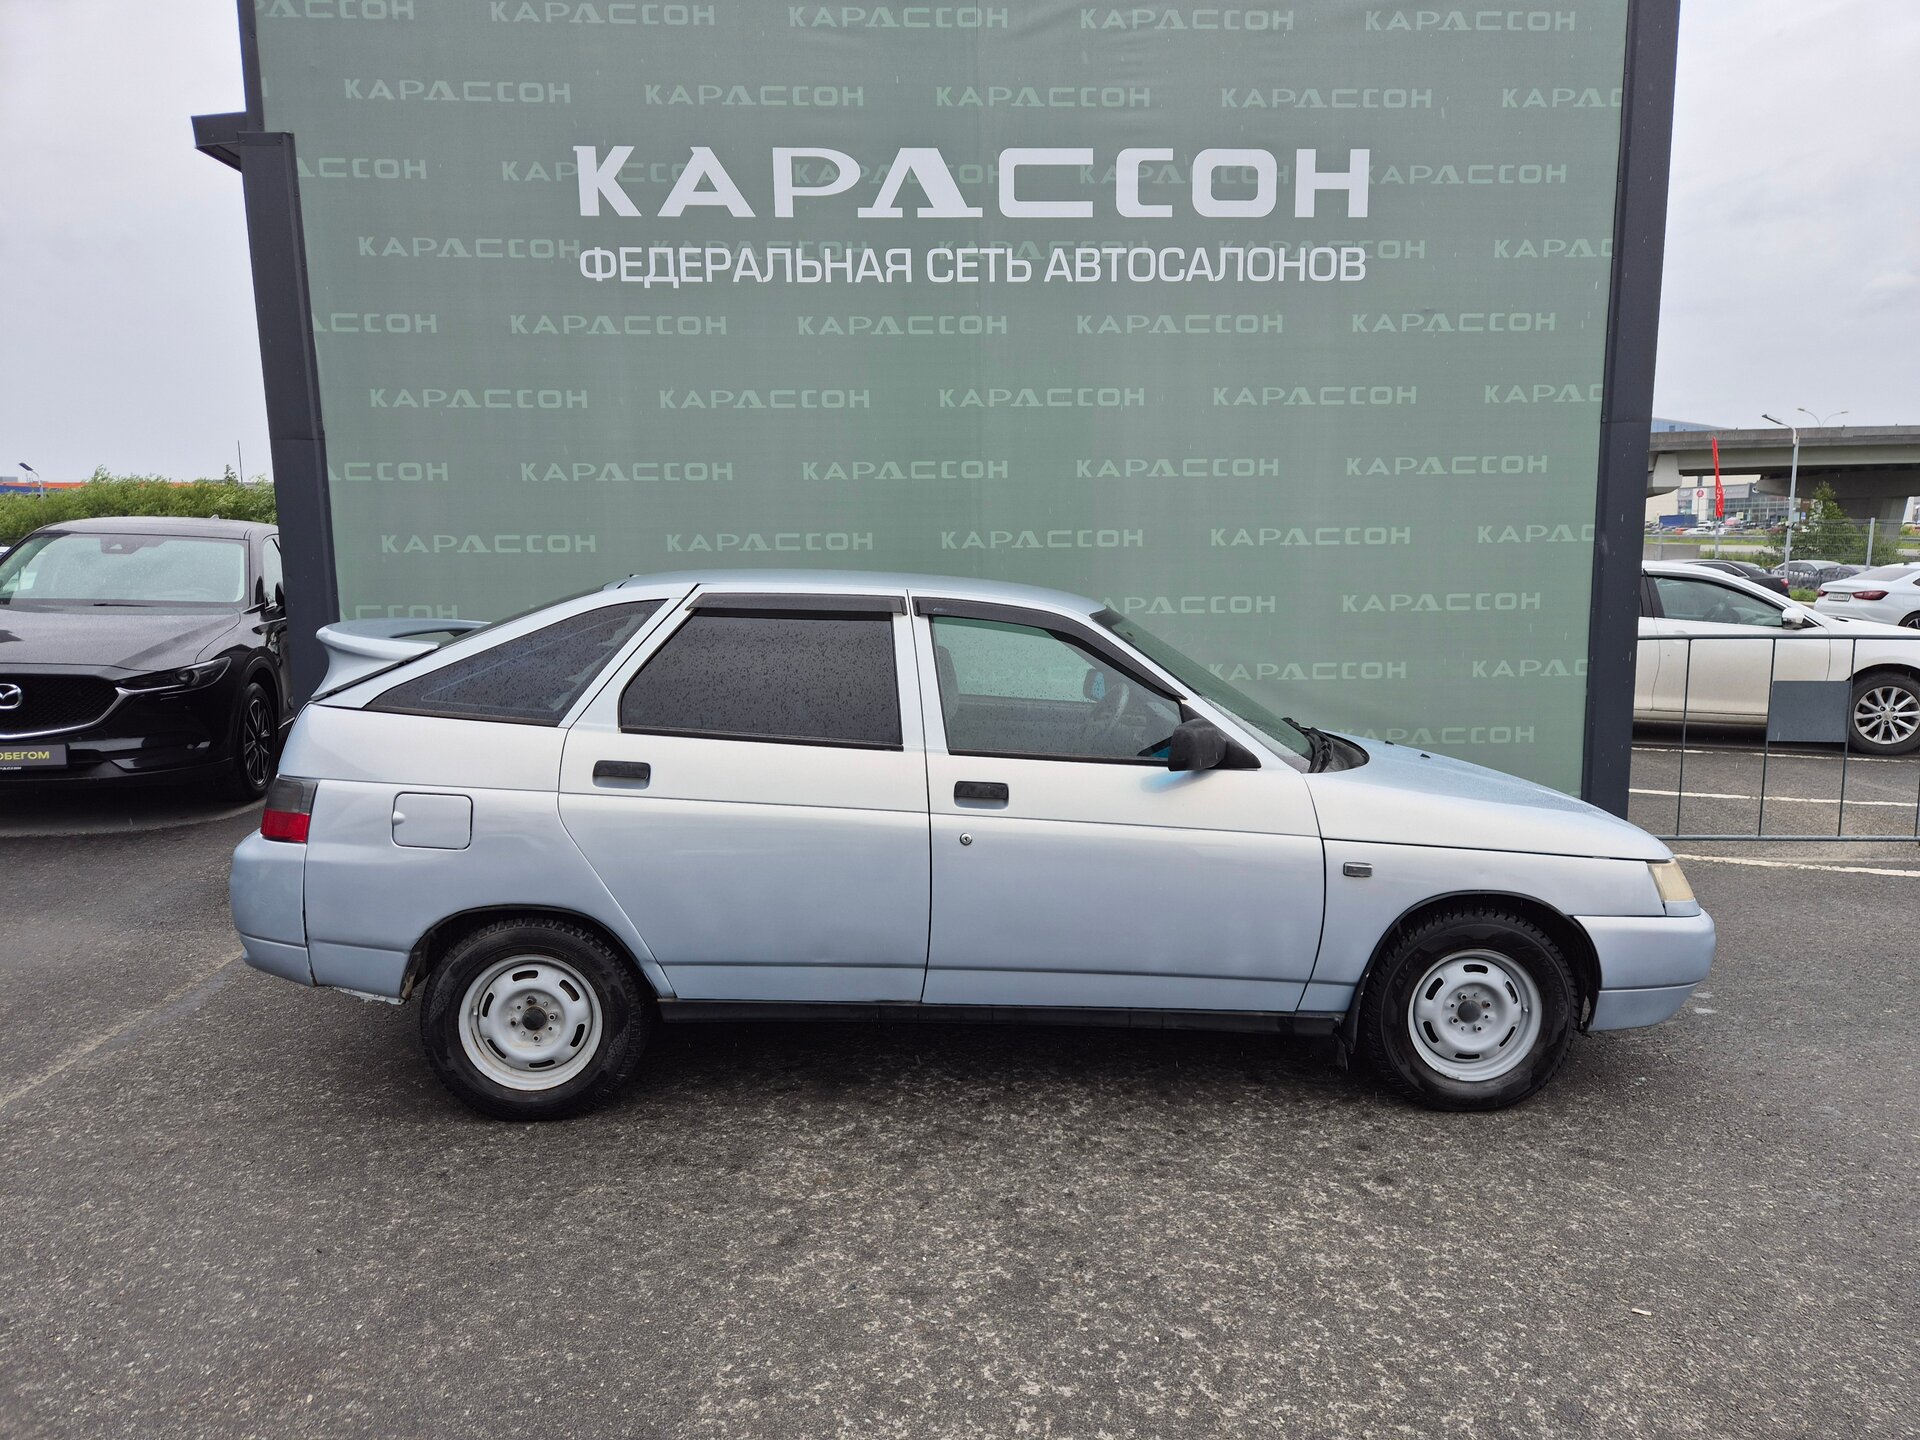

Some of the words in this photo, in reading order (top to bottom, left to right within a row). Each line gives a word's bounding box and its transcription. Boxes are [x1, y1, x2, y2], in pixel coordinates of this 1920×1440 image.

[579, 246, 911, 288] ФЕДЕРАЛЬНАЯ
[926, 247, 1032, 283] СЕТЬ
[1044, 247, 1366, 283] АВТОСАЛОНОВ
